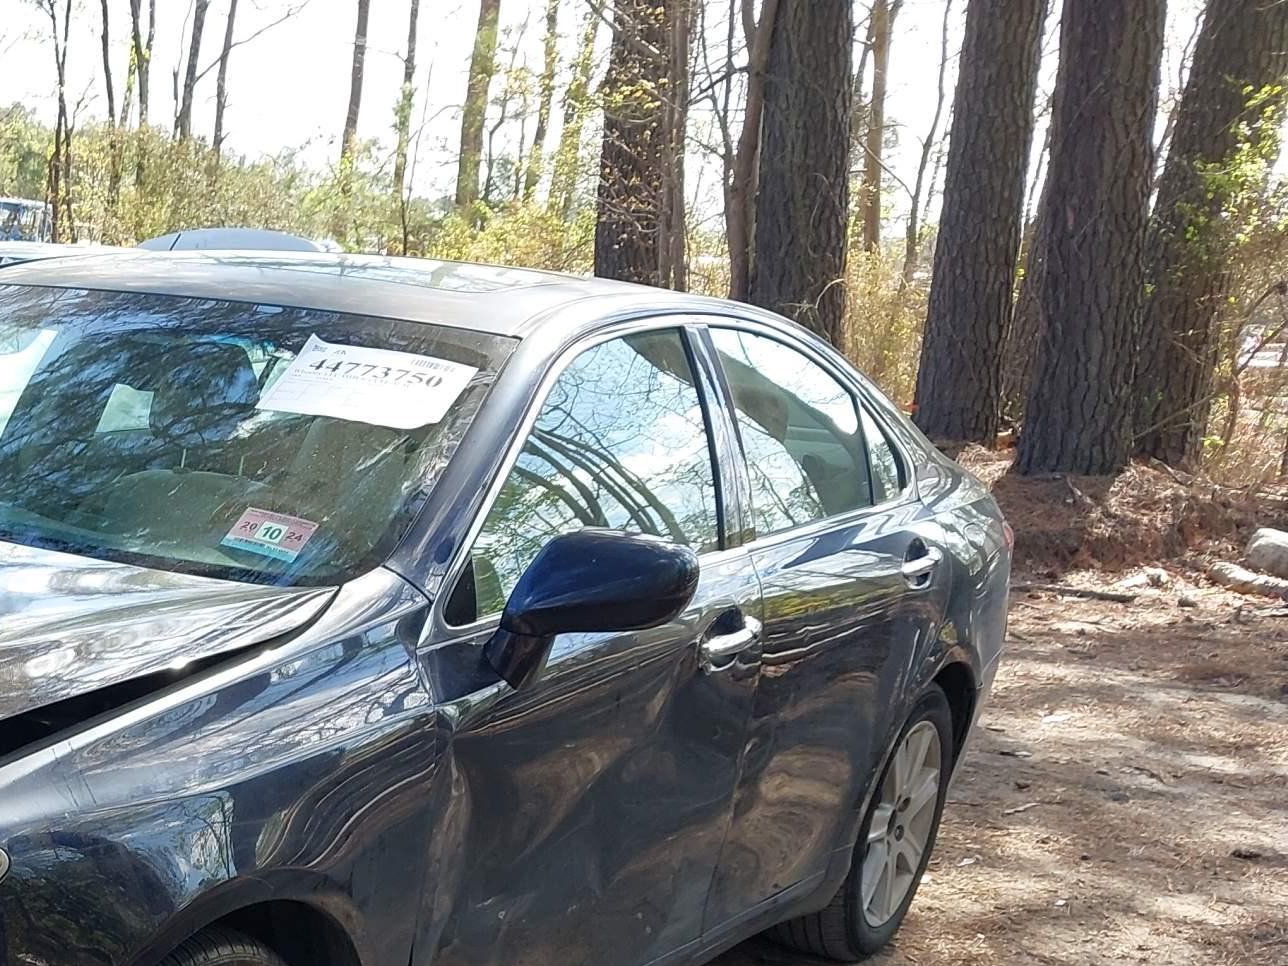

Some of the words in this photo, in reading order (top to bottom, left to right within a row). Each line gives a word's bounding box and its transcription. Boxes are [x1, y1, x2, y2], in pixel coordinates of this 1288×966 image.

[309, 358, 444, 388] 44773750
[240, 521, 258, 531] 20
[262, 526, 282, 540] 10
[285, 531, 304, 542] 24
